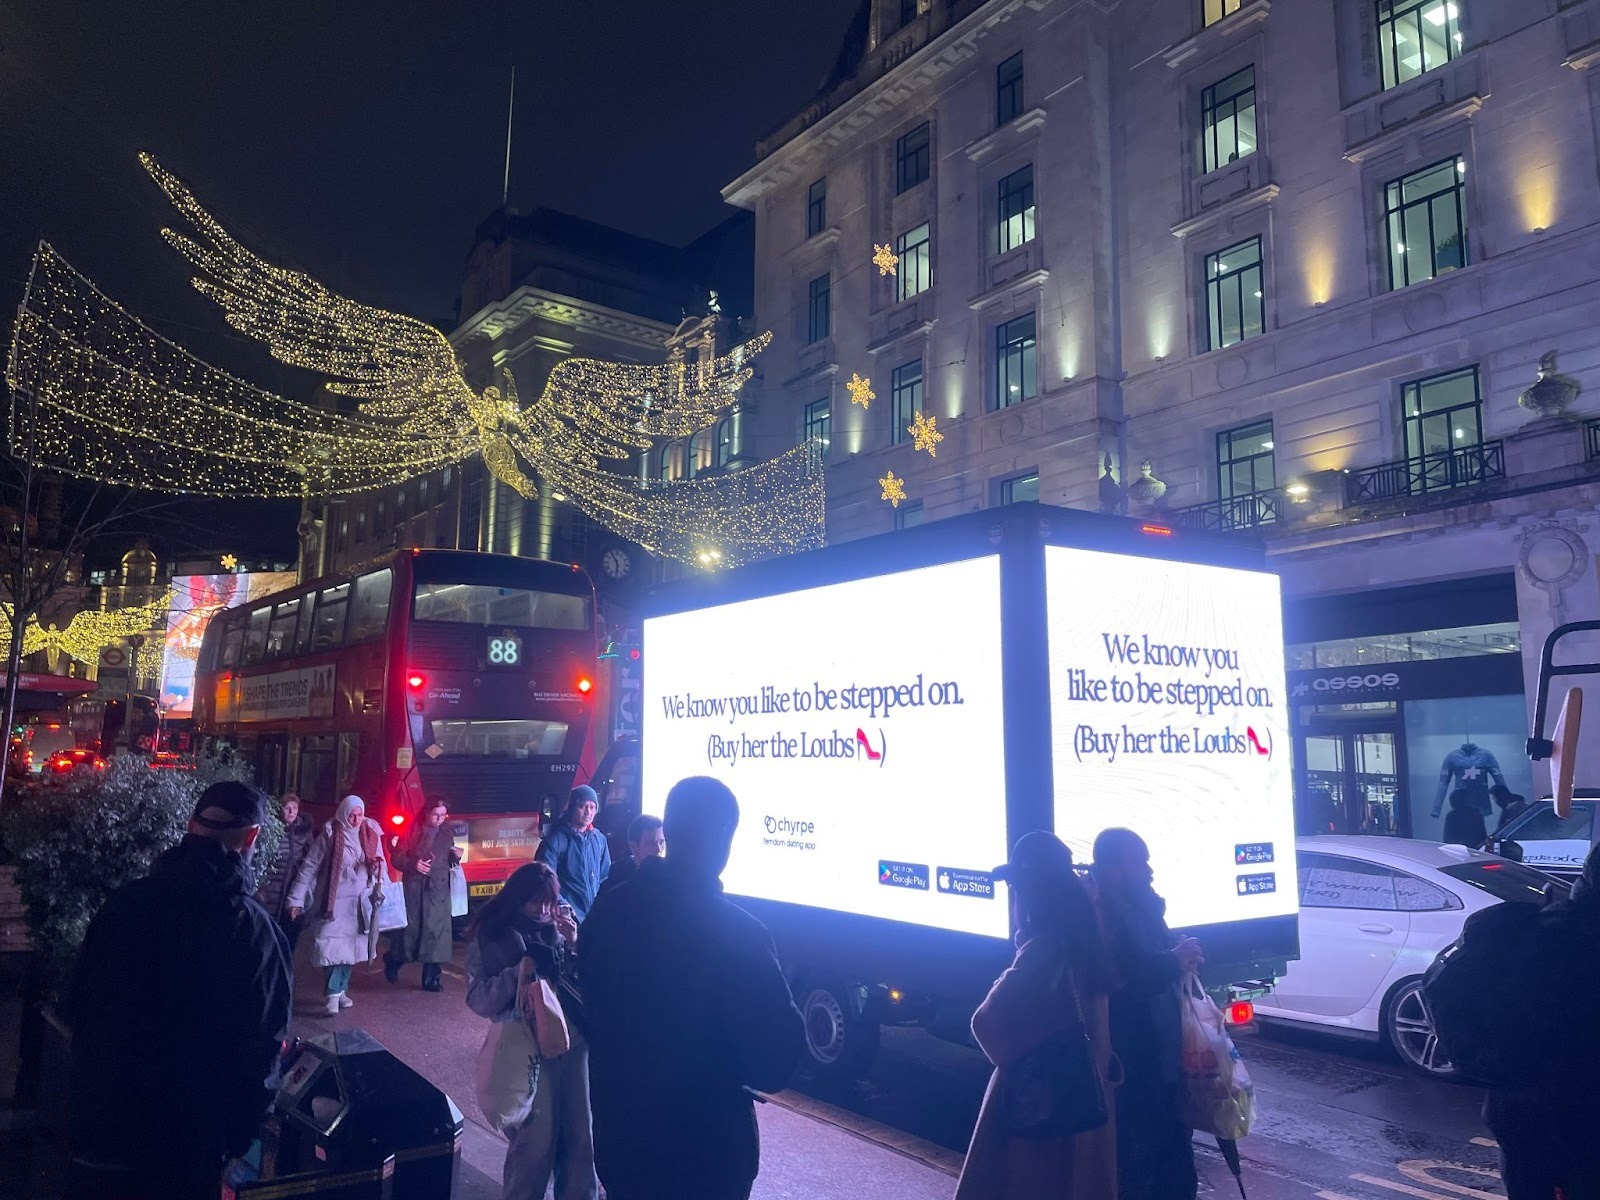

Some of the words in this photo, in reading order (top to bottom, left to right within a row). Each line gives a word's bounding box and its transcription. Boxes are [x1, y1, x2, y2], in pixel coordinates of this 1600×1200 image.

[490, 639, 518, 664] 88
[1102, 632, 1140, 665] We
[1142, 634, 1201, 667] know
[1203, 647, 1239, 678] you
[662, 695, 684, 719] We
[686, 693, 727, 718] know
[727, 696, 758, 724] you
[761, 685, 790, 714] like
[793, 688, 811, 712] to
[814, 682, 837, 711] be
[840, 673, 924, 718] stepped
[928, 680, 964, 706] on.
[1067, 668, 1107, 702] like
[1111, 674, 1134, 703] to
[1135, 672, 1163, 704] be
[1166, 677, 1244, 715] stepped
[1246, 686, 1273, 708] on.
[707, 733, 741, 767] (Buy
[741, 732, 769, 758] her
[770, 731, 798, 759] the
[1074, 723, 1120, 763] (Buy
[1121, 724, 1157, 754] her
[1159, 725, 1190, 754] the
[551, 764, 576, 772] EH292
[778, 816, 815, 837] chyrpe
[482, 839, 494, 849] NOT
[495, 839, 509, 848] JUST
[510, 838, 525, 847] SKIN
[786, 838, 804, 850] dating
[804, 842, 816, 850] app
[892, 873, 913, 886] Google
[913, 876, 926, 889] Play
[952, 879, 968, 892] App
[969, 881, 991, 894] Store
